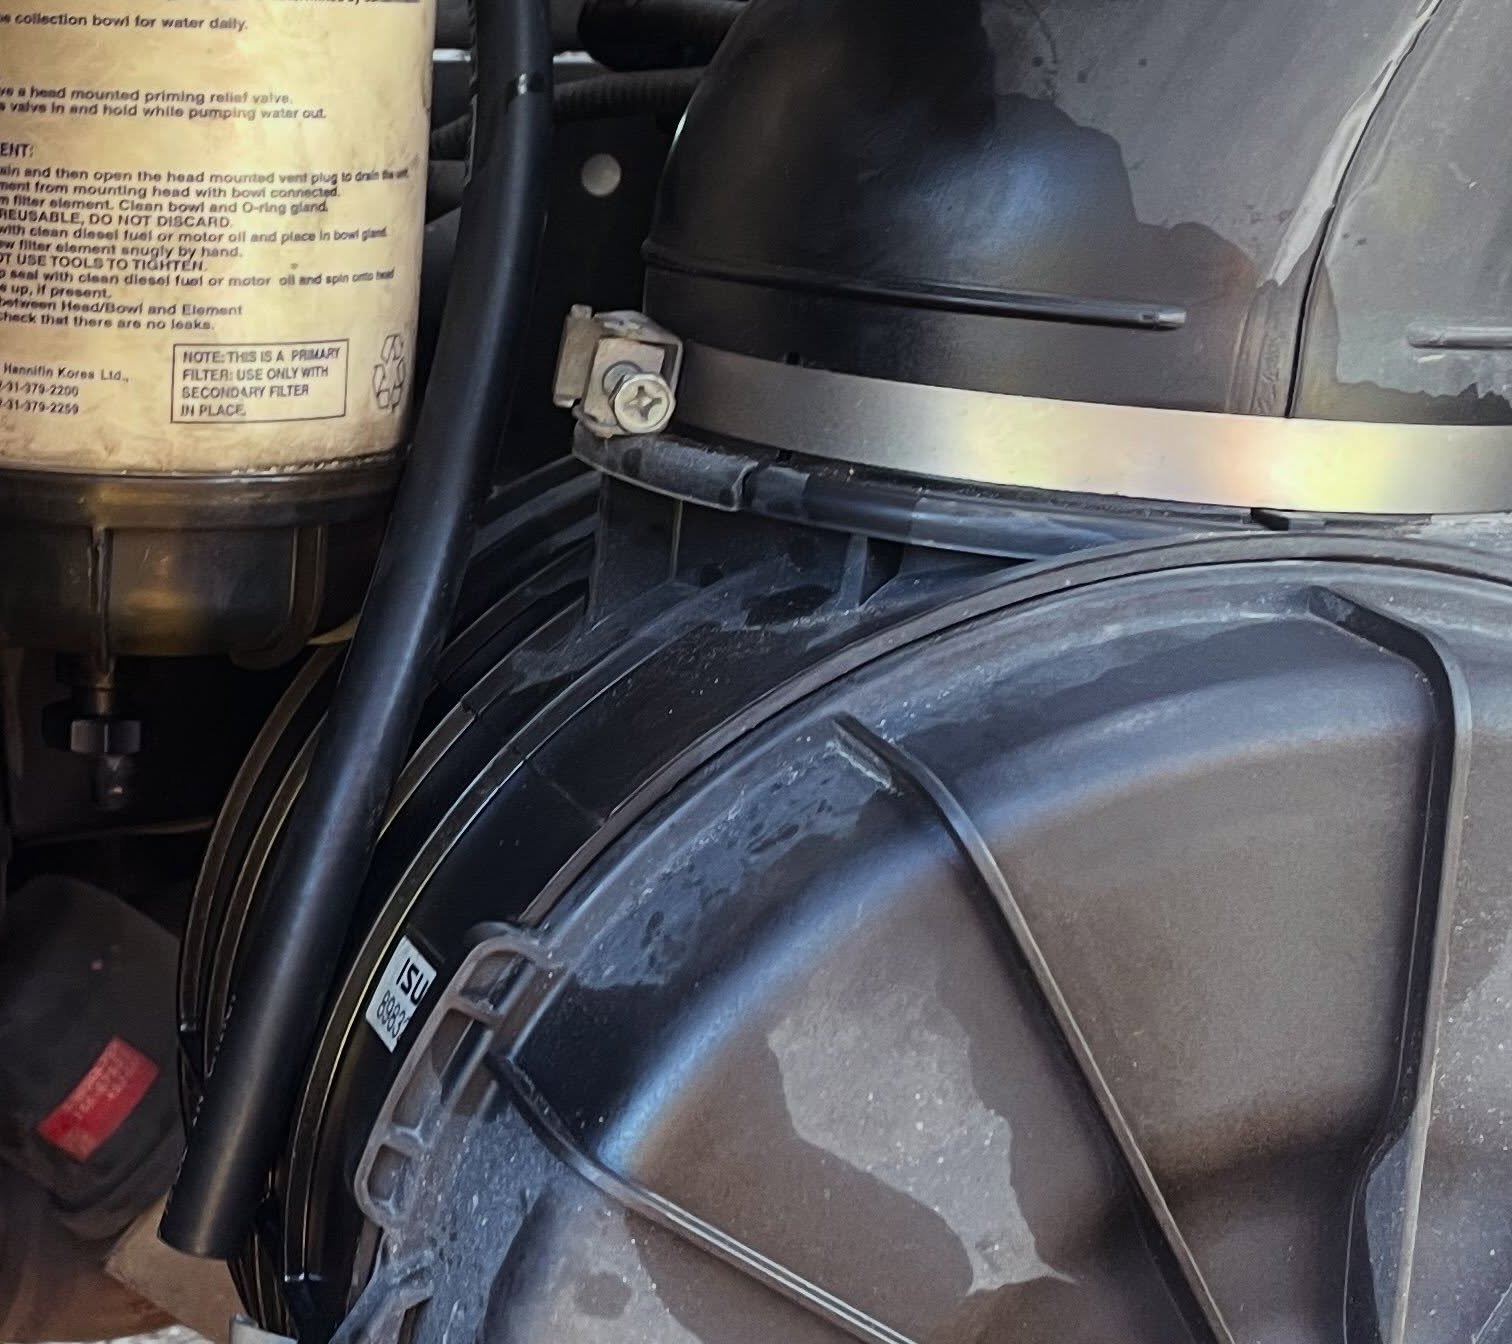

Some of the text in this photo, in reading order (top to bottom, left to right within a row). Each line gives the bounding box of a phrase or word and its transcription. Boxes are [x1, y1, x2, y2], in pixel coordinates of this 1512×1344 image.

[14, 12, 250, 33] collection bowl for water daily.
[29, 85, 250, 107] head mounted priming relief
[10, 100, 328, 123] valve in and hold while pumping water out.
[23, 166, 52, 180] and
[54, 166, 90, 182] then
[93, 169, 133, 186] open
[137, 169, 162, 184] the
[166, 170, 206, 185] head
[209, 170, 275, 185] mounted
[278, 171, 308, 185] vent
[311, 169, 338, 187] plug
[34, 181, 70, 195] from
[73, 183, 147, 200] mounting
[151, 185, 191, 199] head
[194, 186, 228, 200] with
[231, 185, 267, 200] bowl
[270, 185, 341, 200] connected.
[13, 193, 46, 207] filter
[118, 199, 164, 214] Clean
[167, 199, 206, 214] bowl
[209, 200, 238, 214] and
[241, 200, 288, 216] O-ring
[290, 200, 330, 216] gland.
[88, 211, 114, 226] DO
[117, 213, 152, 227] NOT
[29, 223, 69, 239] clean
[73, 225, 120, 242] diesel
[122, 229, 154, 243] fuel
[156, 231, 175, 243] or
[178, 230, 224, 243] motor
[227, 230, 247, 243] oil
[250, 230, 278, 243] and
[280, 229, 317, 244] place
[318, 229, 332, 242] in
[333, 227, 361, 242] bowl
[18, 238, 52, 253] filter
[54, 241, 117, 255] element
[121, 243, 173, 259] snugly
[177, 244, 198, 260] by
[200, 244, 244, 258] hand.
[16, 253, 47, 268] USE
[50, 254, 105, 271] TOOLS
[108, 258, 129, 272] TO
[132, 258, 209, 272] TIGHTEN.
[9, 267, 39, 281] seal
[42, 269, 75, 284] with
[78, 271, 120, 286] clean
[123, 273, 171, 287] diesel
[174, 273, 205, 287] fuel
[207, 276, 225, 288] or
[227, 275, 272, 288] motor
[278, 273, 297, 286] oil
[298, 273, 324, 286] and
[325, 271, 351, 287] spin
[11, 283, 35, 299] up,
[37, 285, 47, 298] if
[49, 286, 114, 300] present.
[60, 298, 144, 316] Head/Bowl
[147, 303, 178, 316] and
[181, 303, 244, 317] Element
[40, 312, 71, 327] that
[72, 314, 115, 329] there
[116, 317, 144, 330] are
[145, 319, 167, 331] no
[170, 317, 216, 332] leaks.
[227, 346, 342, 364] THIS IS A PRIMARY
[3, 361, 55, 379] Hannifin
[57, 365, 96, 382] Korea
[182, 365, 330, 382] FILTER: USE ONLY WITH
[181, 383, 311, 400] SECONDARY FILTER
[180, 403, 196, 418] IN
